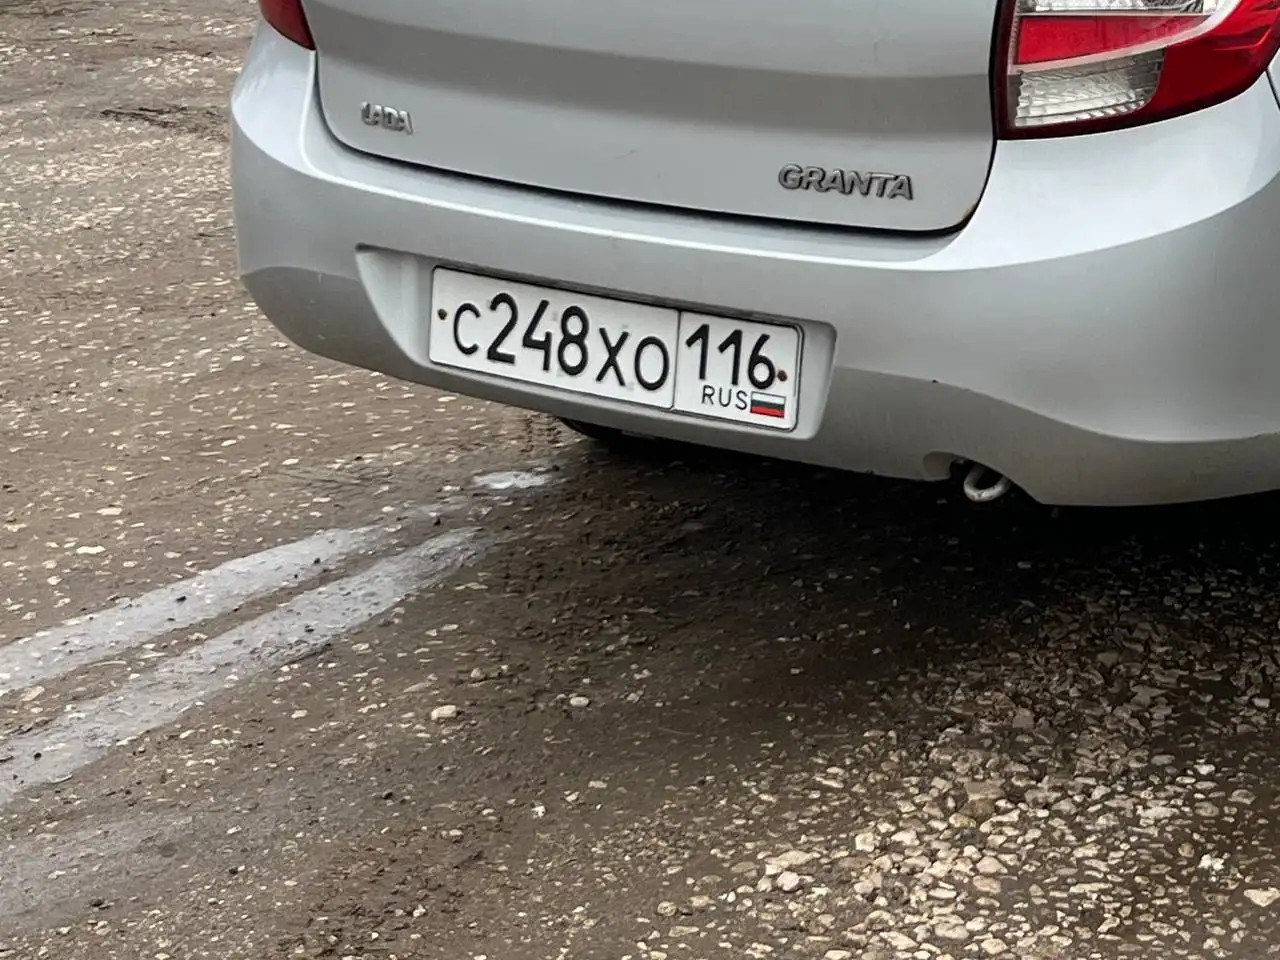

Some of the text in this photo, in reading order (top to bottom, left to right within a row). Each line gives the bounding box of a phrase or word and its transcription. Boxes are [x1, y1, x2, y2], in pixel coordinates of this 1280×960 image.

[361, 101, 414, 136] LADA
[778, 163, 913, 200] GRANTA
[702, 385, 748, 411] RUS
